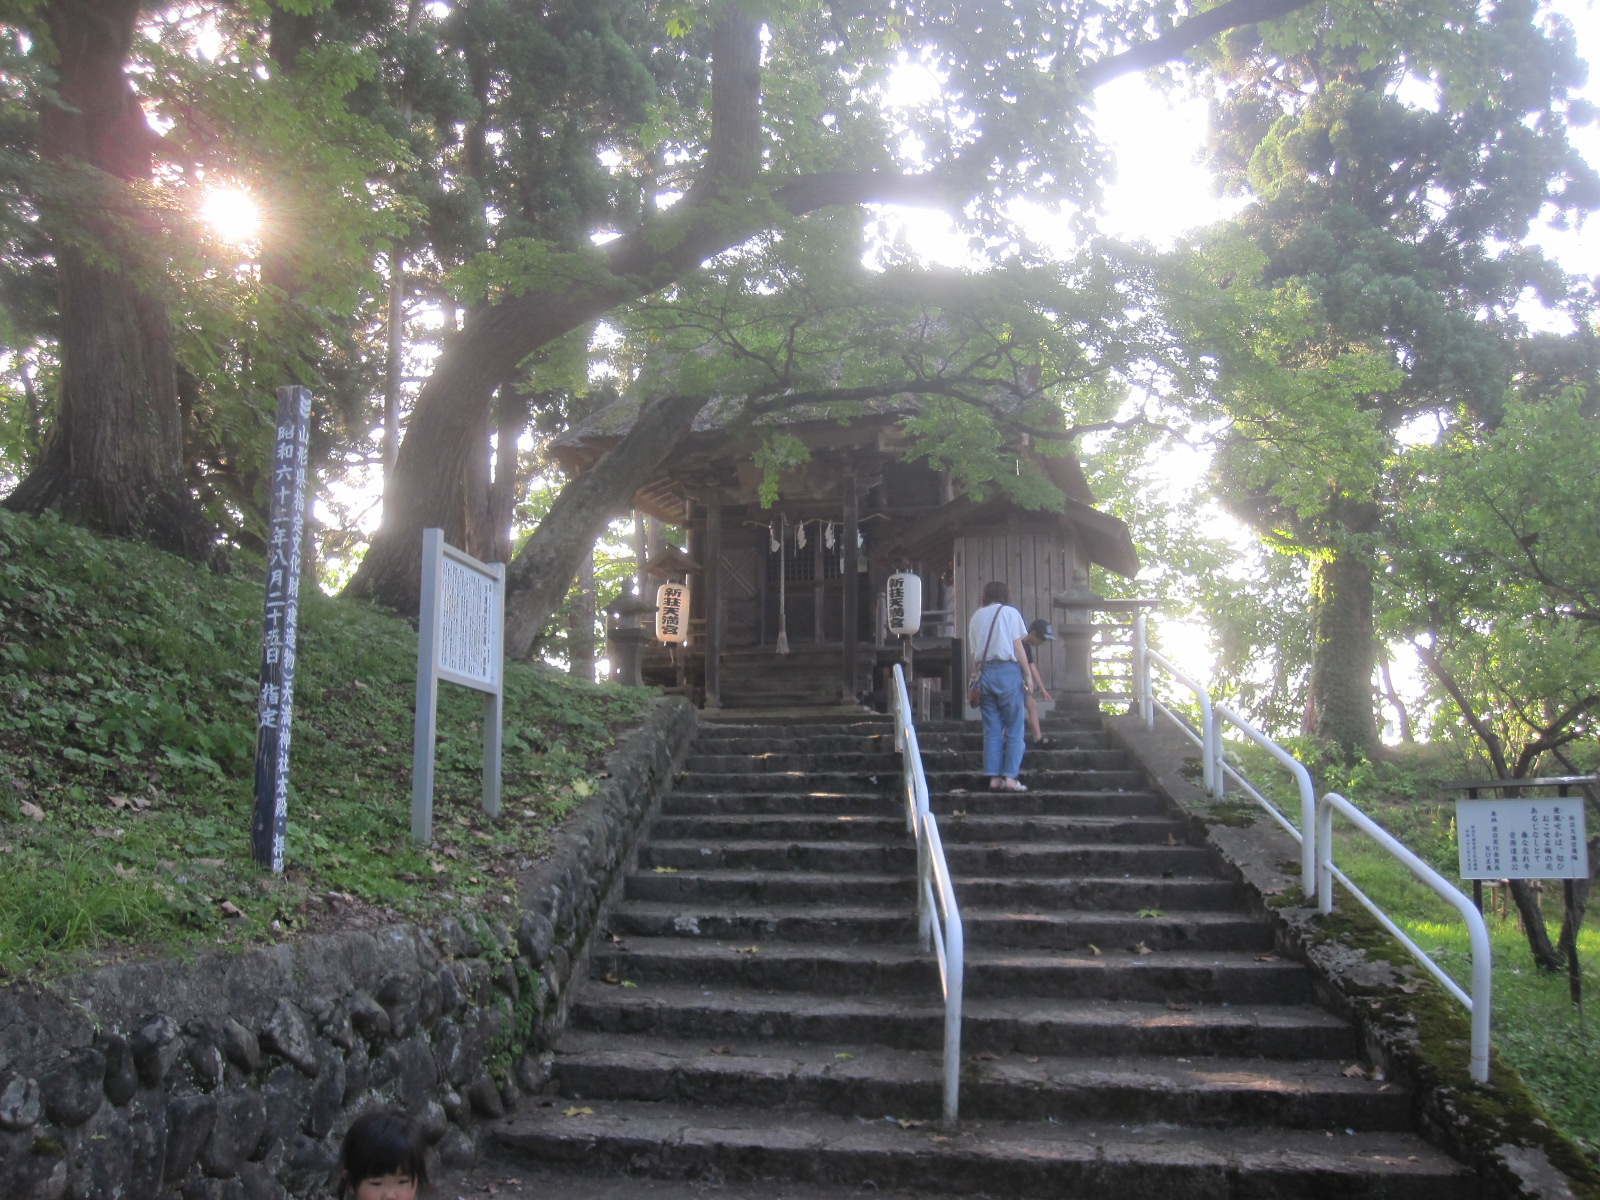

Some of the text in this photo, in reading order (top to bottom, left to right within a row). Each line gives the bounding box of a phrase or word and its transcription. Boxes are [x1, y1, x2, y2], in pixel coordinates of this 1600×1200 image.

[1531, 807, 1540, 862] あるじなしとて
